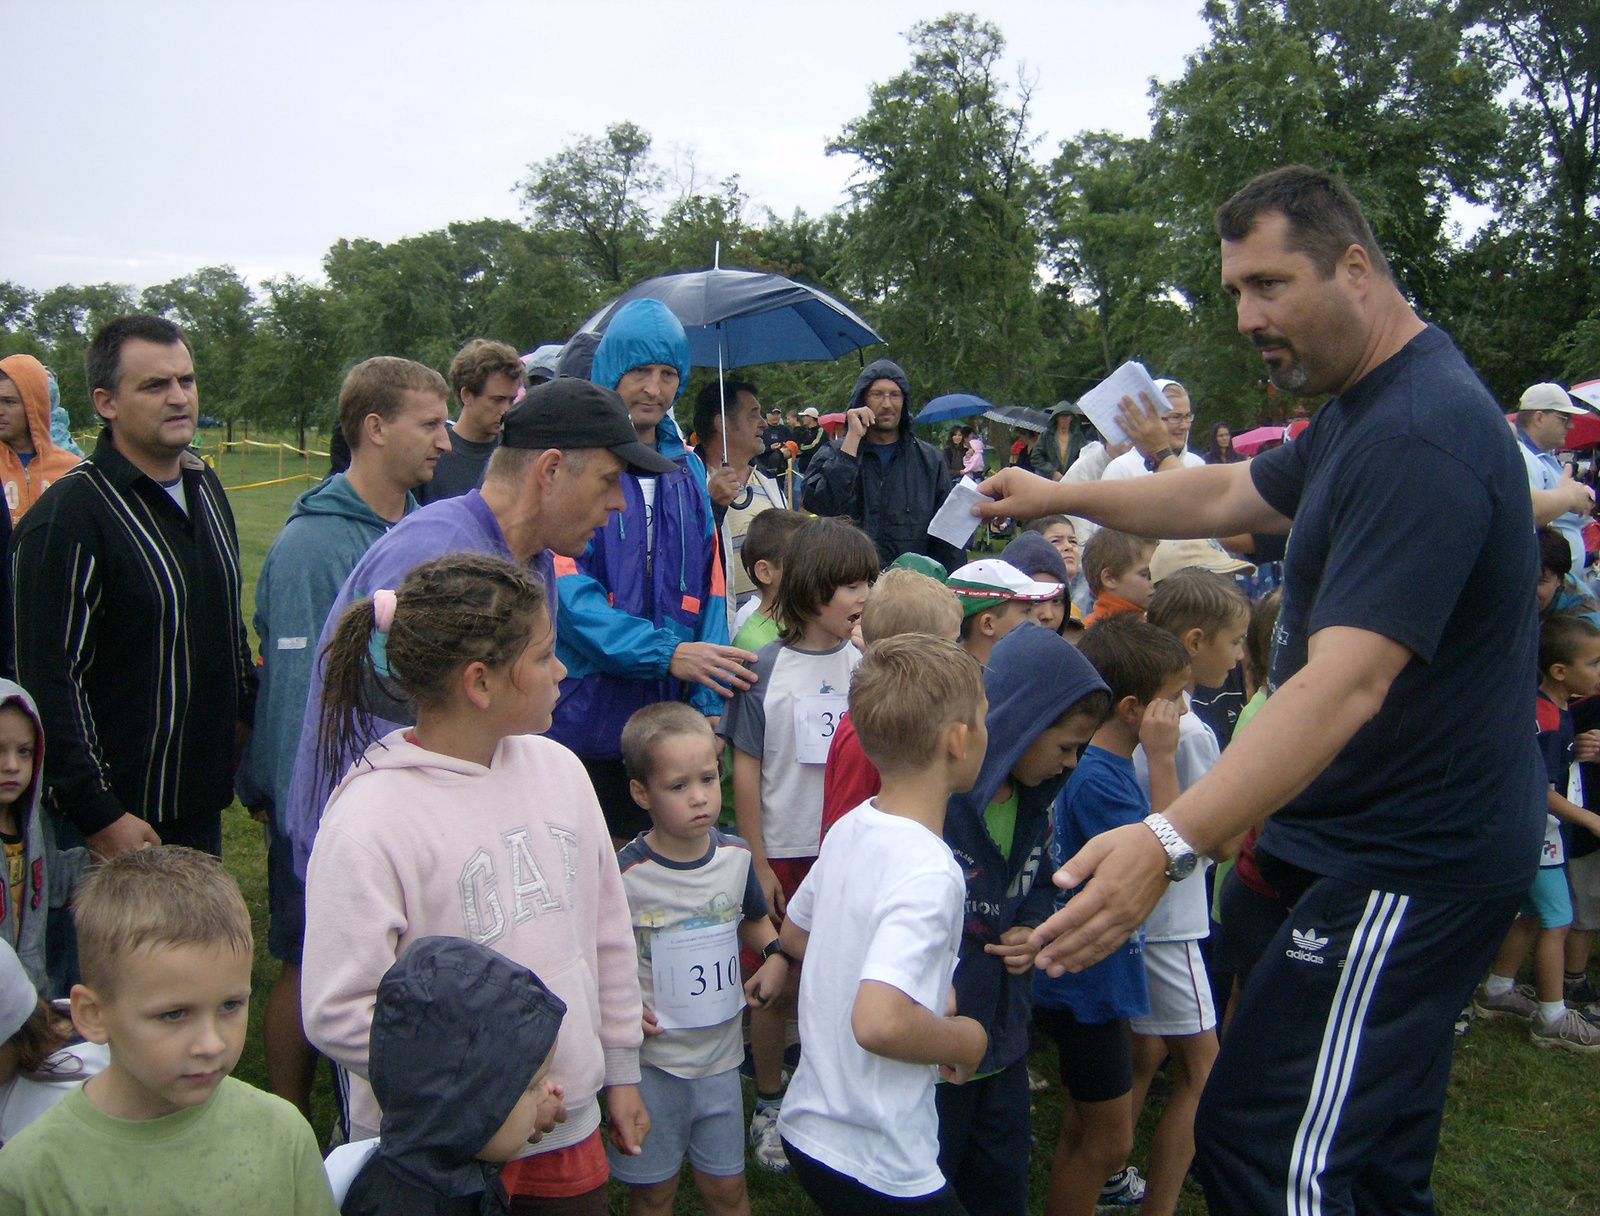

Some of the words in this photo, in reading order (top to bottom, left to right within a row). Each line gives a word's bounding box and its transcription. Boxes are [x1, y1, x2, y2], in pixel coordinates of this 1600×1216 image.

[964, 900, 1000, 916] TION
[1285, 949, 1324, 965] adidas
[689, 955, 738, 996] 310
